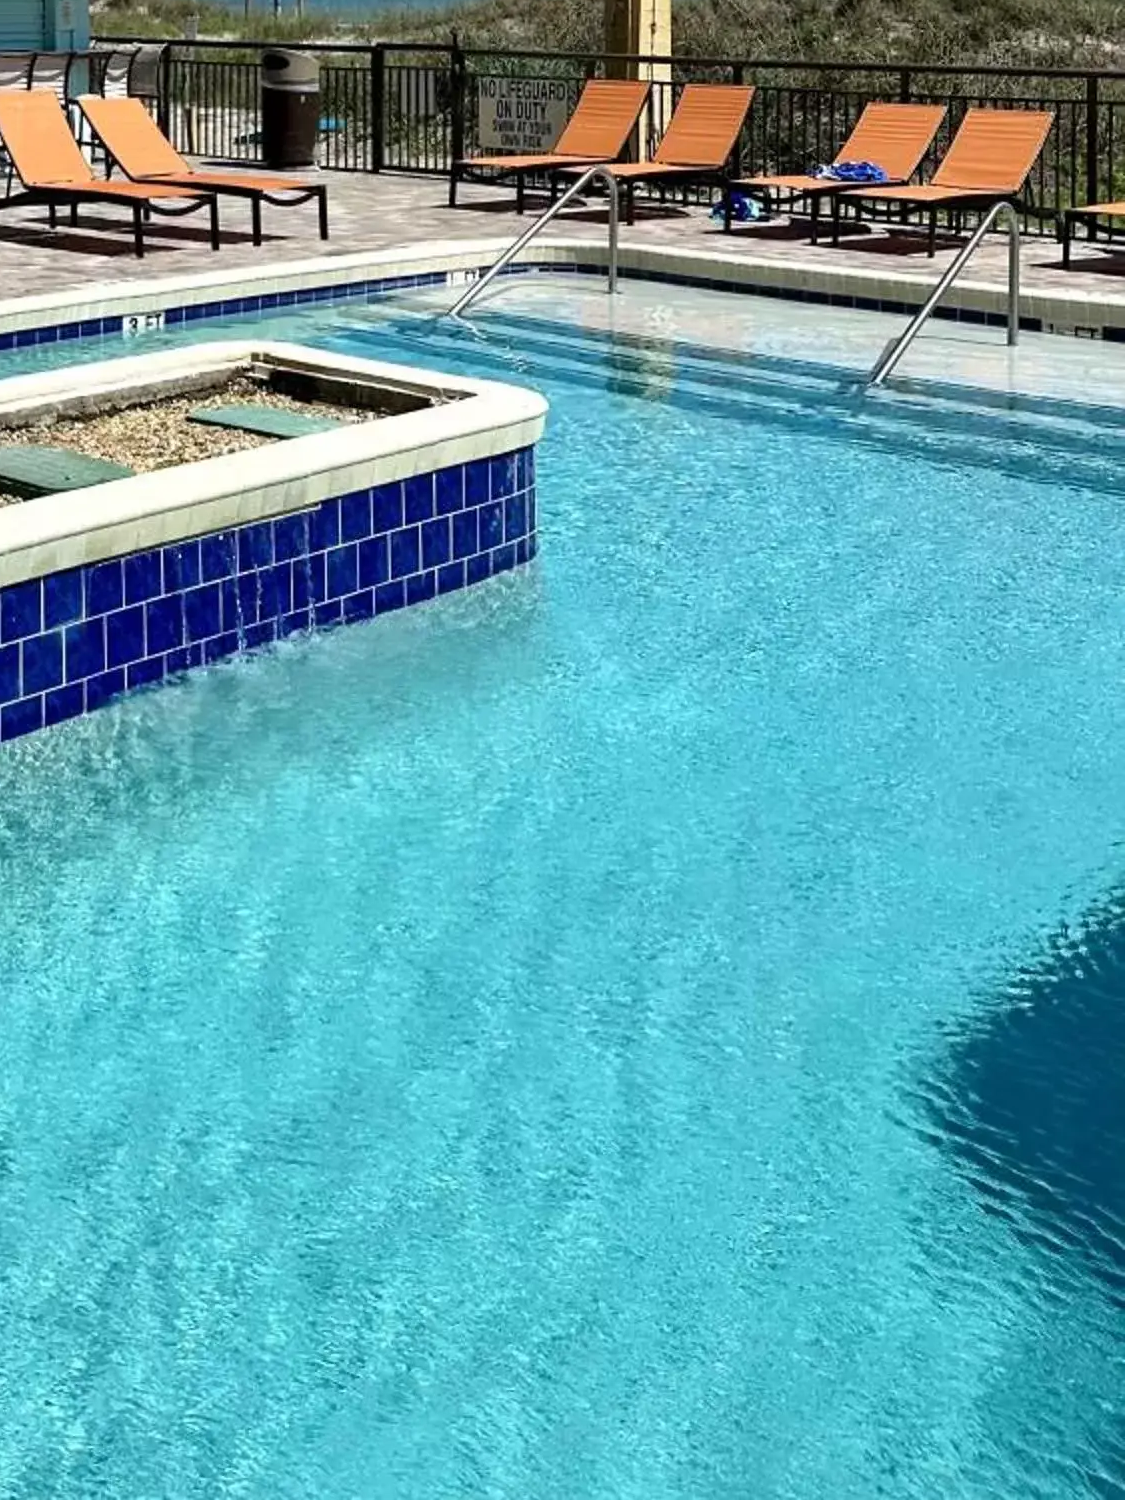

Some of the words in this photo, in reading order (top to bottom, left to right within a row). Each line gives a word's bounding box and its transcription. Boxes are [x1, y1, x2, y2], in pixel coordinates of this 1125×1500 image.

[481, 80, 495, 97] NO
[498, 81, 565, 100] LIFEGUARD
[497, 100, 512, 118] ON
[516, 101, 546, 120] DUTY
